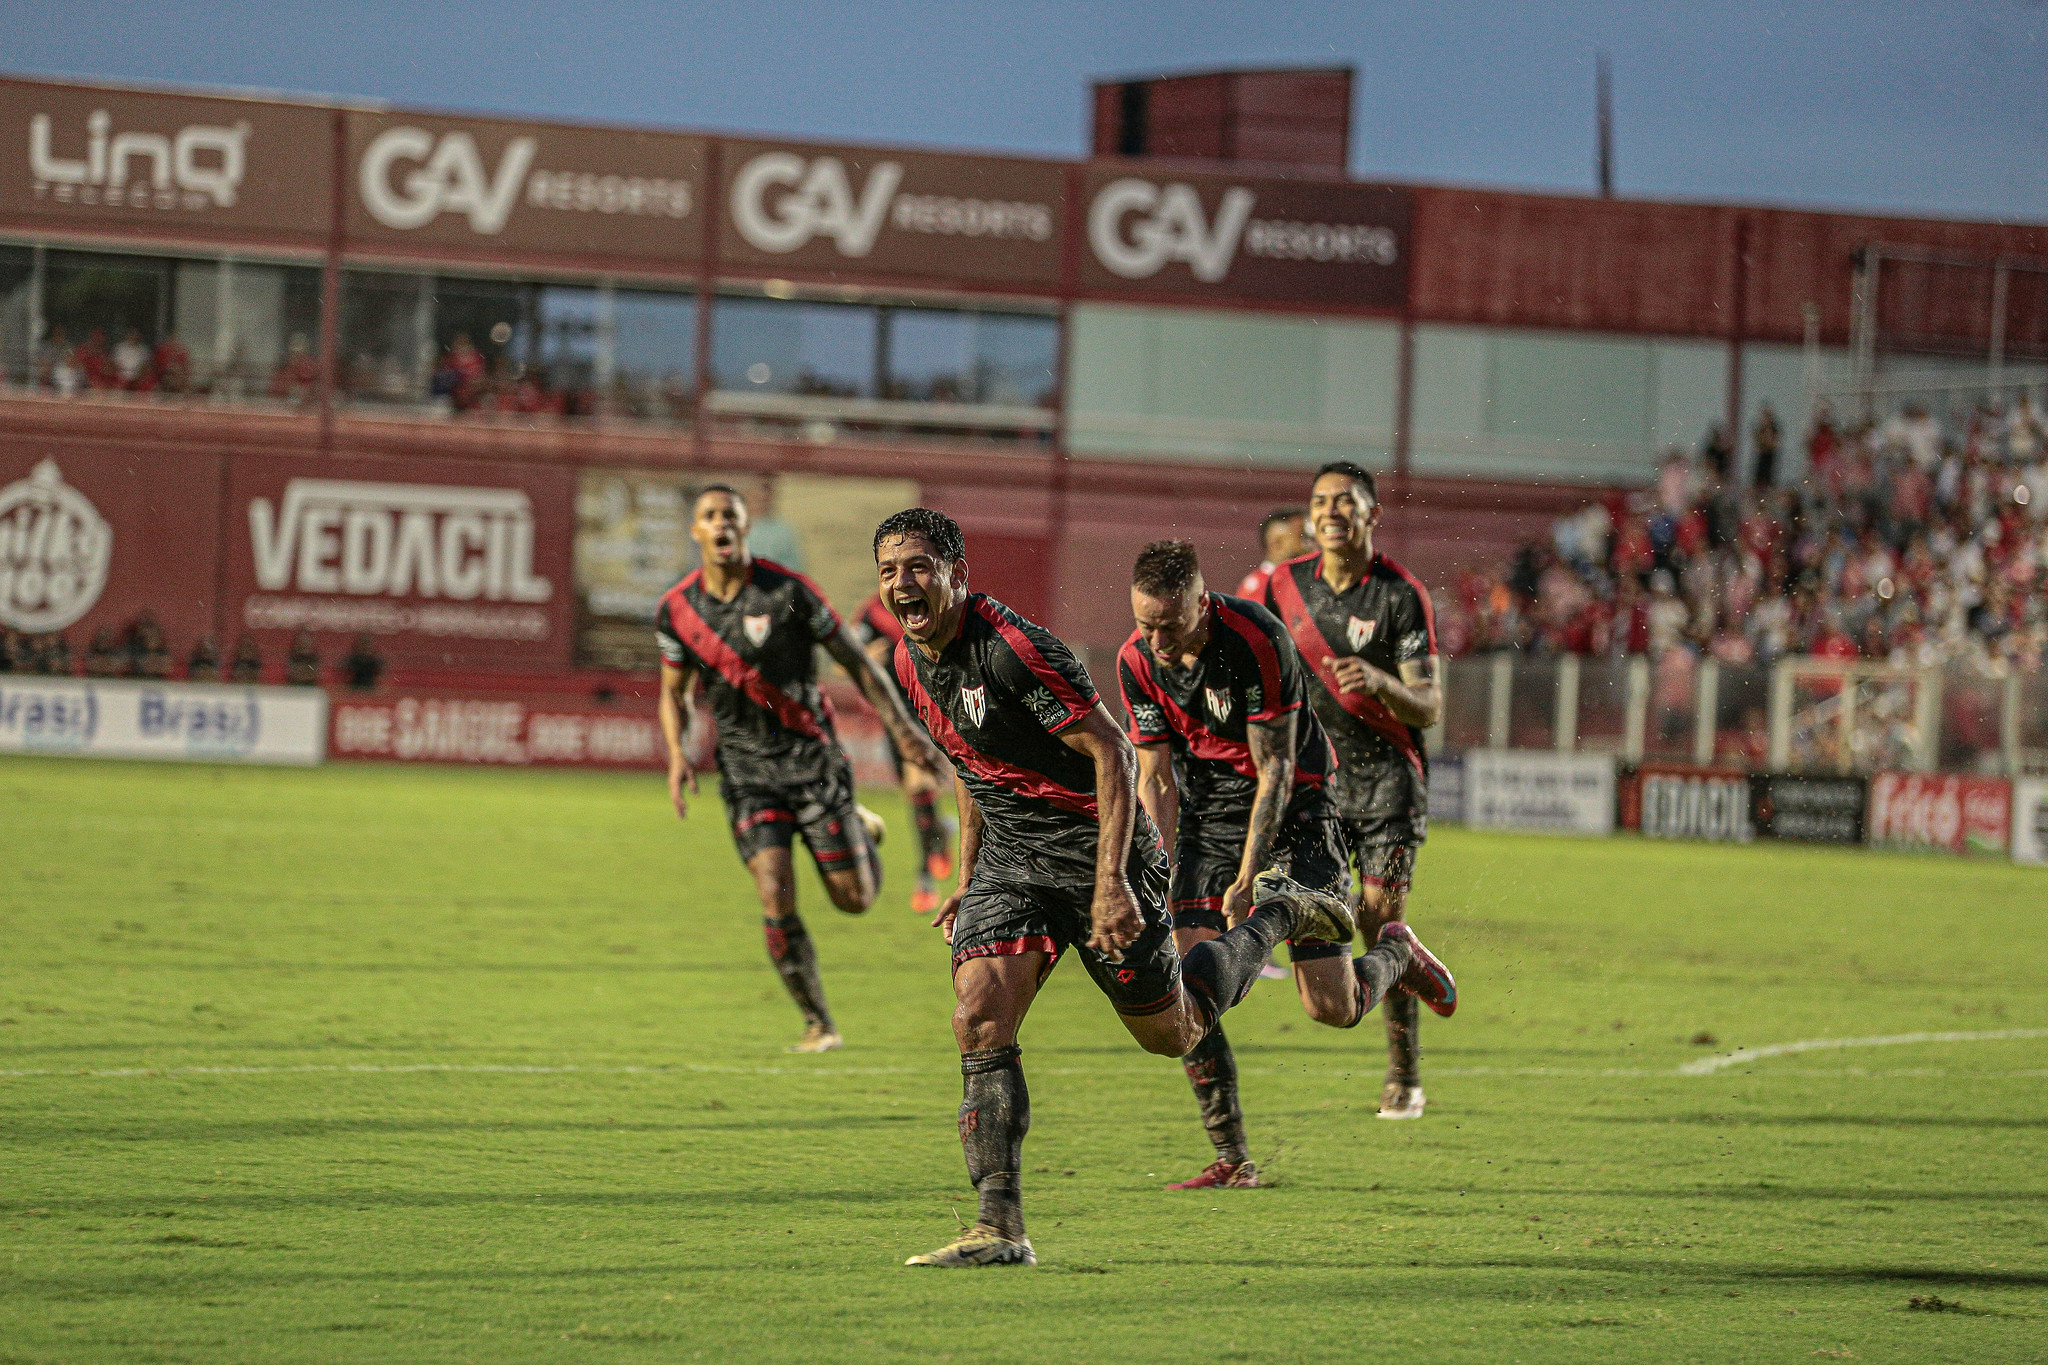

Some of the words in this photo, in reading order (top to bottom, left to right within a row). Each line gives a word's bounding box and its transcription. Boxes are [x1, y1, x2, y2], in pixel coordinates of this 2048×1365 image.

[360, 126, 538, 235] GAV
[529, 168, 693, 219] RESORTS
[731, 151, 904, 258] GAV
[896, 192, 1053, 243] RESORTS
[1088, 177, 1258, 283] GAV
[1243, 217, 1398, 267] RESORTS
[248, 477, 552, 602] VEDACIL
